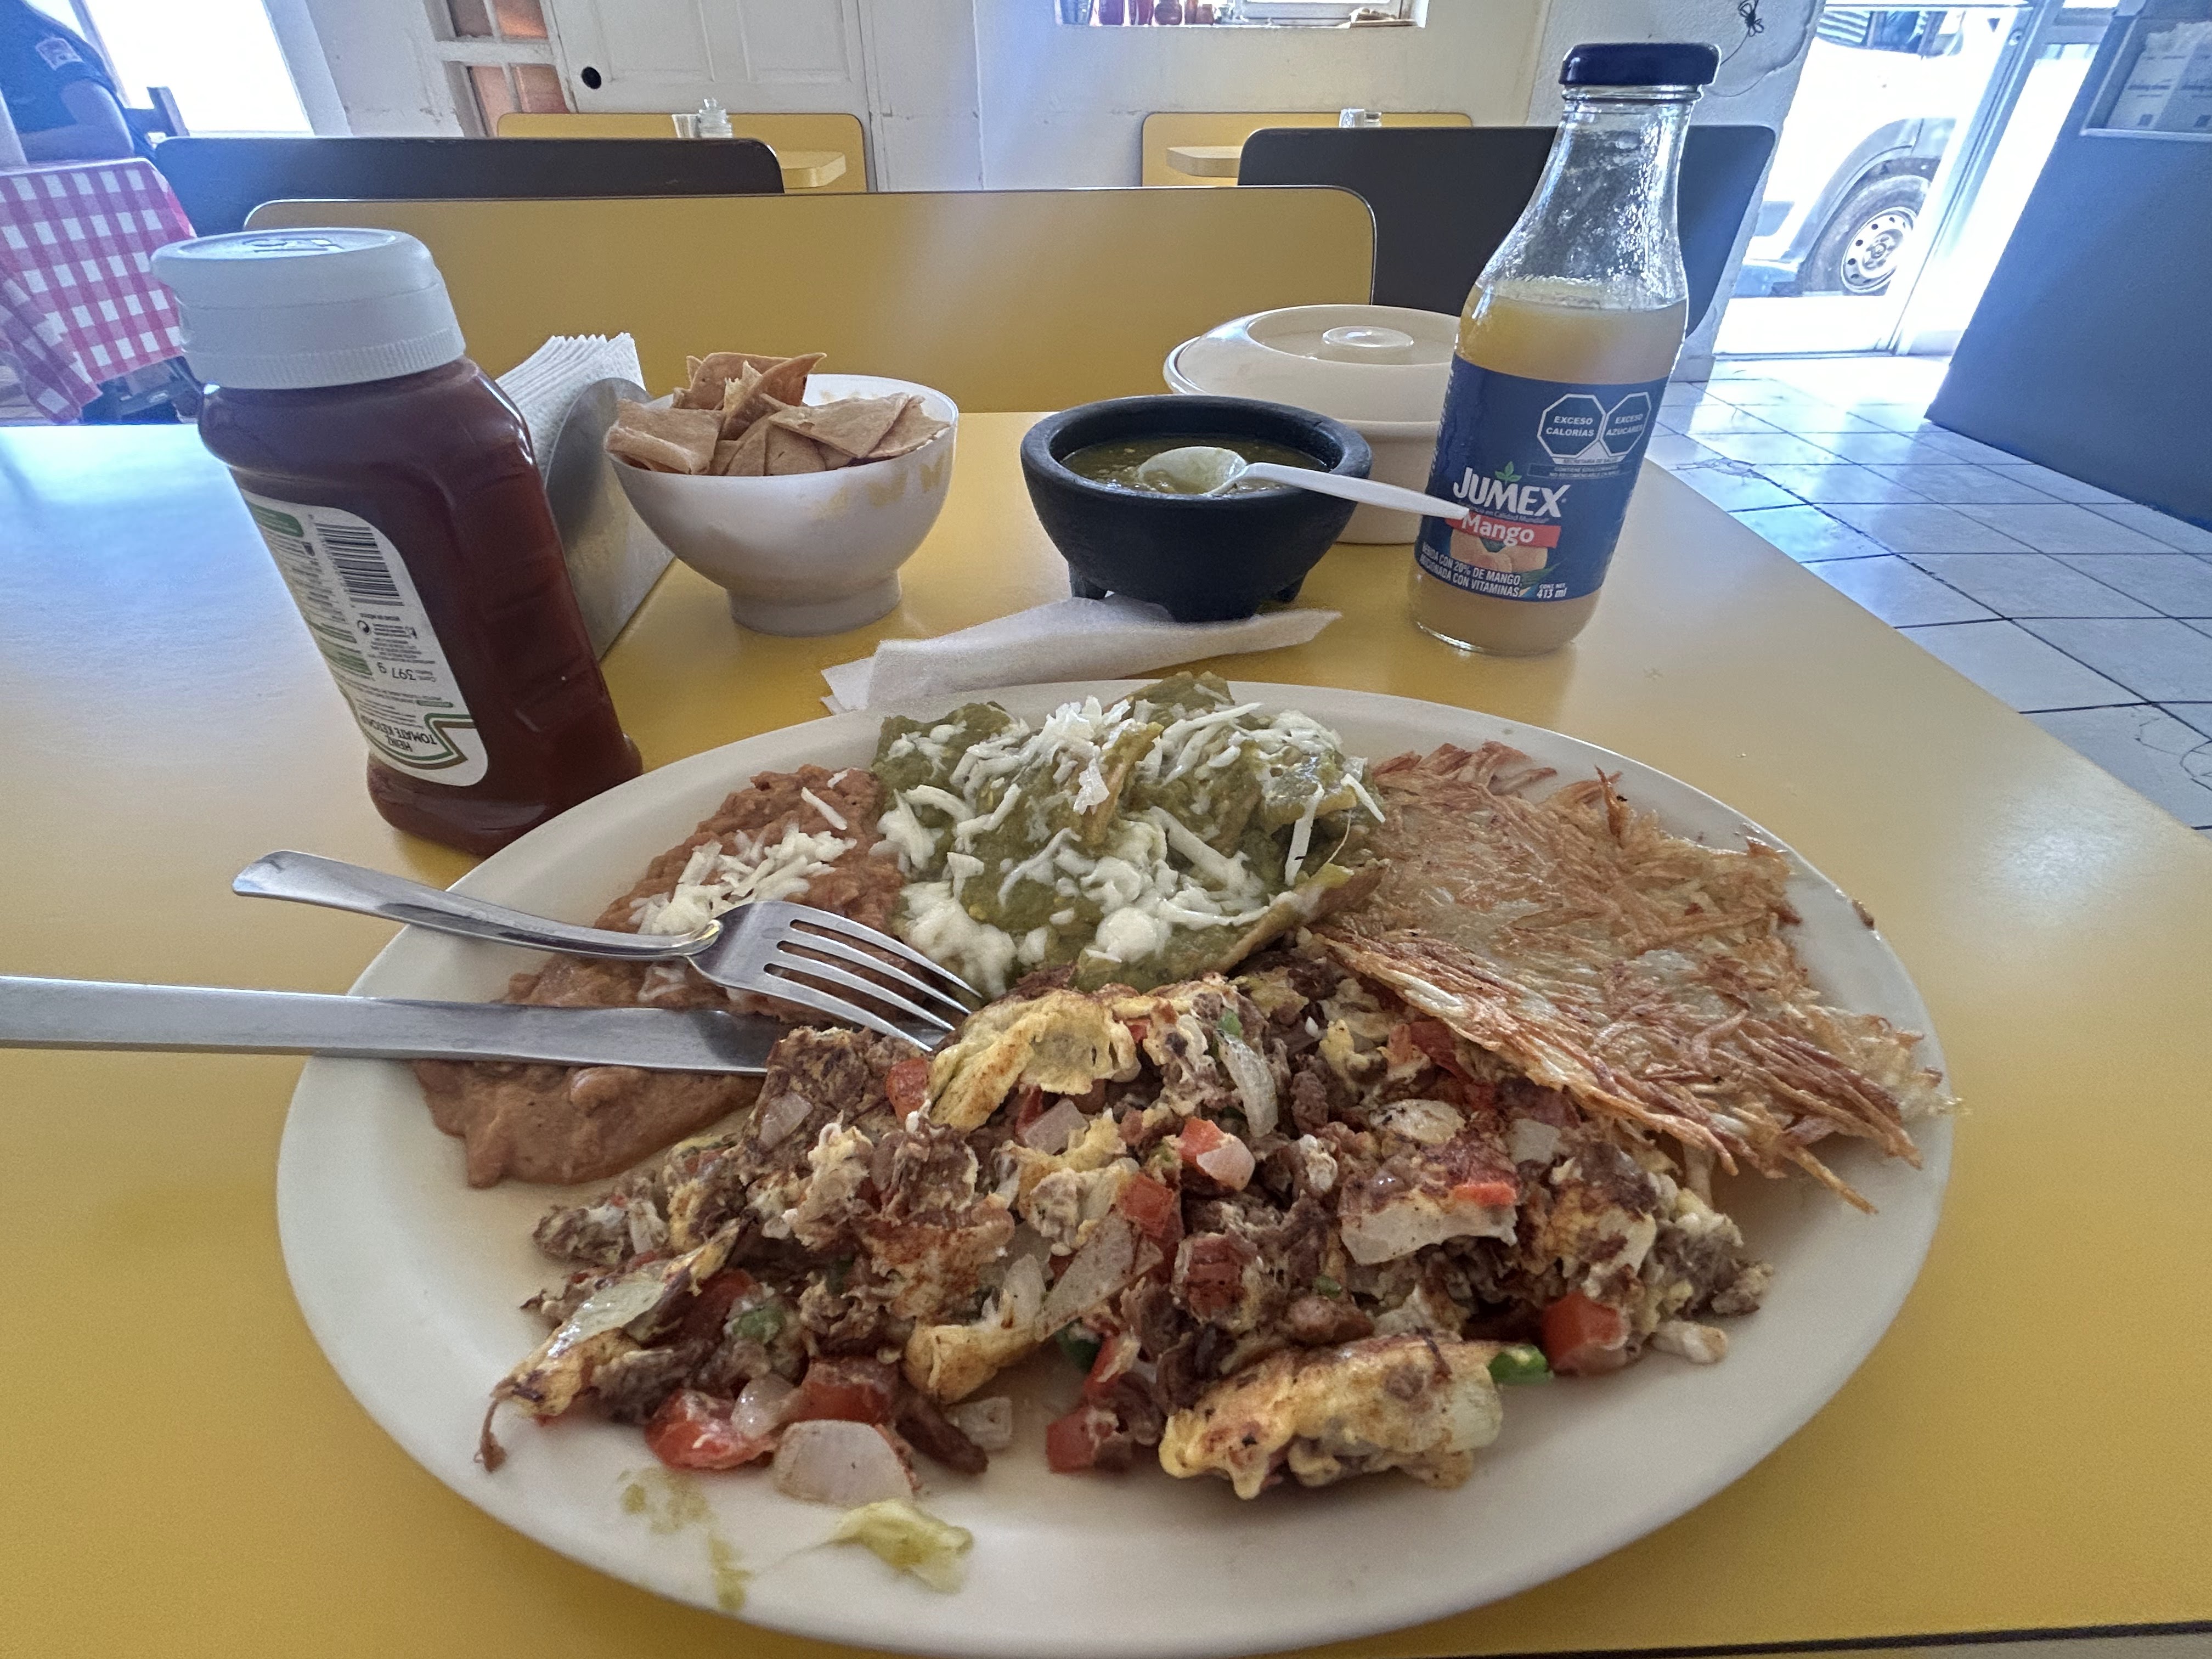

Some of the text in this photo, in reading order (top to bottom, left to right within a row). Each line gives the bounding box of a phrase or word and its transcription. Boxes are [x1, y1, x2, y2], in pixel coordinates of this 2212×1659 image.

[1554, 416, 1593, 425] EXCESO
[1615, 414, 1644, 424] EXCESO
[1453, 467, 1571, 517] JUMEX
[1462, 513, 1534, 546] Mango
[1438, 554, 1453, 568] CON
[1454, 561, 1471, 575] 20%
[1472, 567, 1484, 580] DE
[1453, 574, 1469, 587] CON
[1537, 587, 1567, 599] 413 ml
[377, 662, 387, 674] g
[392, 668, 416, 681] 397
